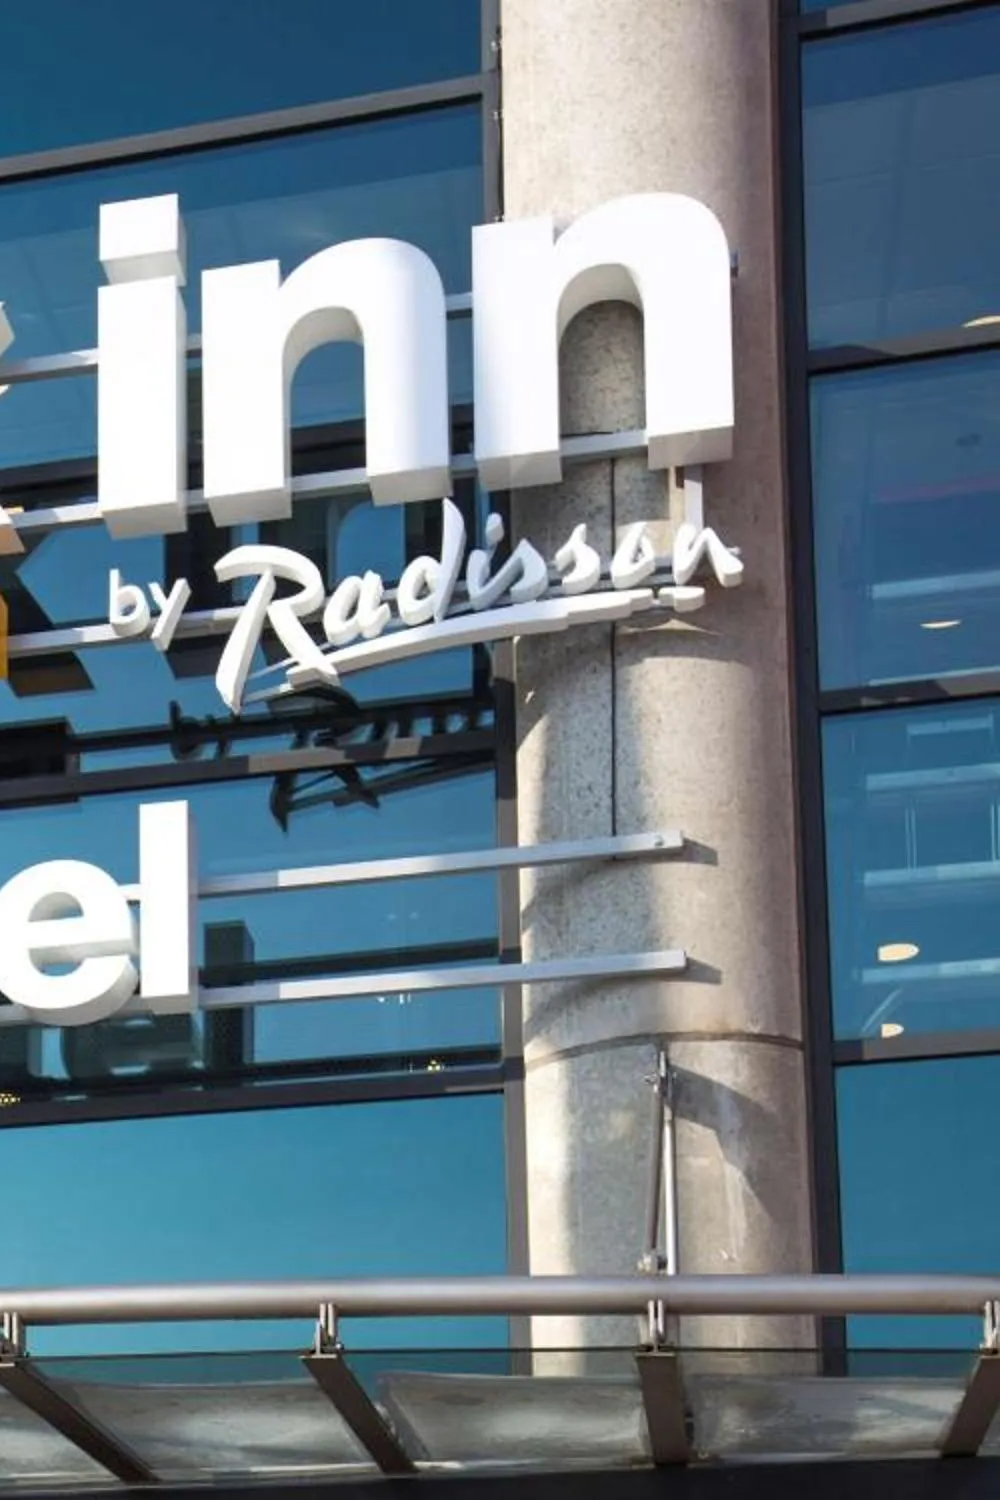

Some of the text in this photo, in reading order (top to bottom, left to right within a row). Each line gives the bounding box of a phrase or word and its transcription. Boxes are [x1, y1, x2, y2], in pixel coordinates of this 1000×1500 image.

[98, 192, 735, 536] inn
[109, 497, 744, 715] by Radisson
